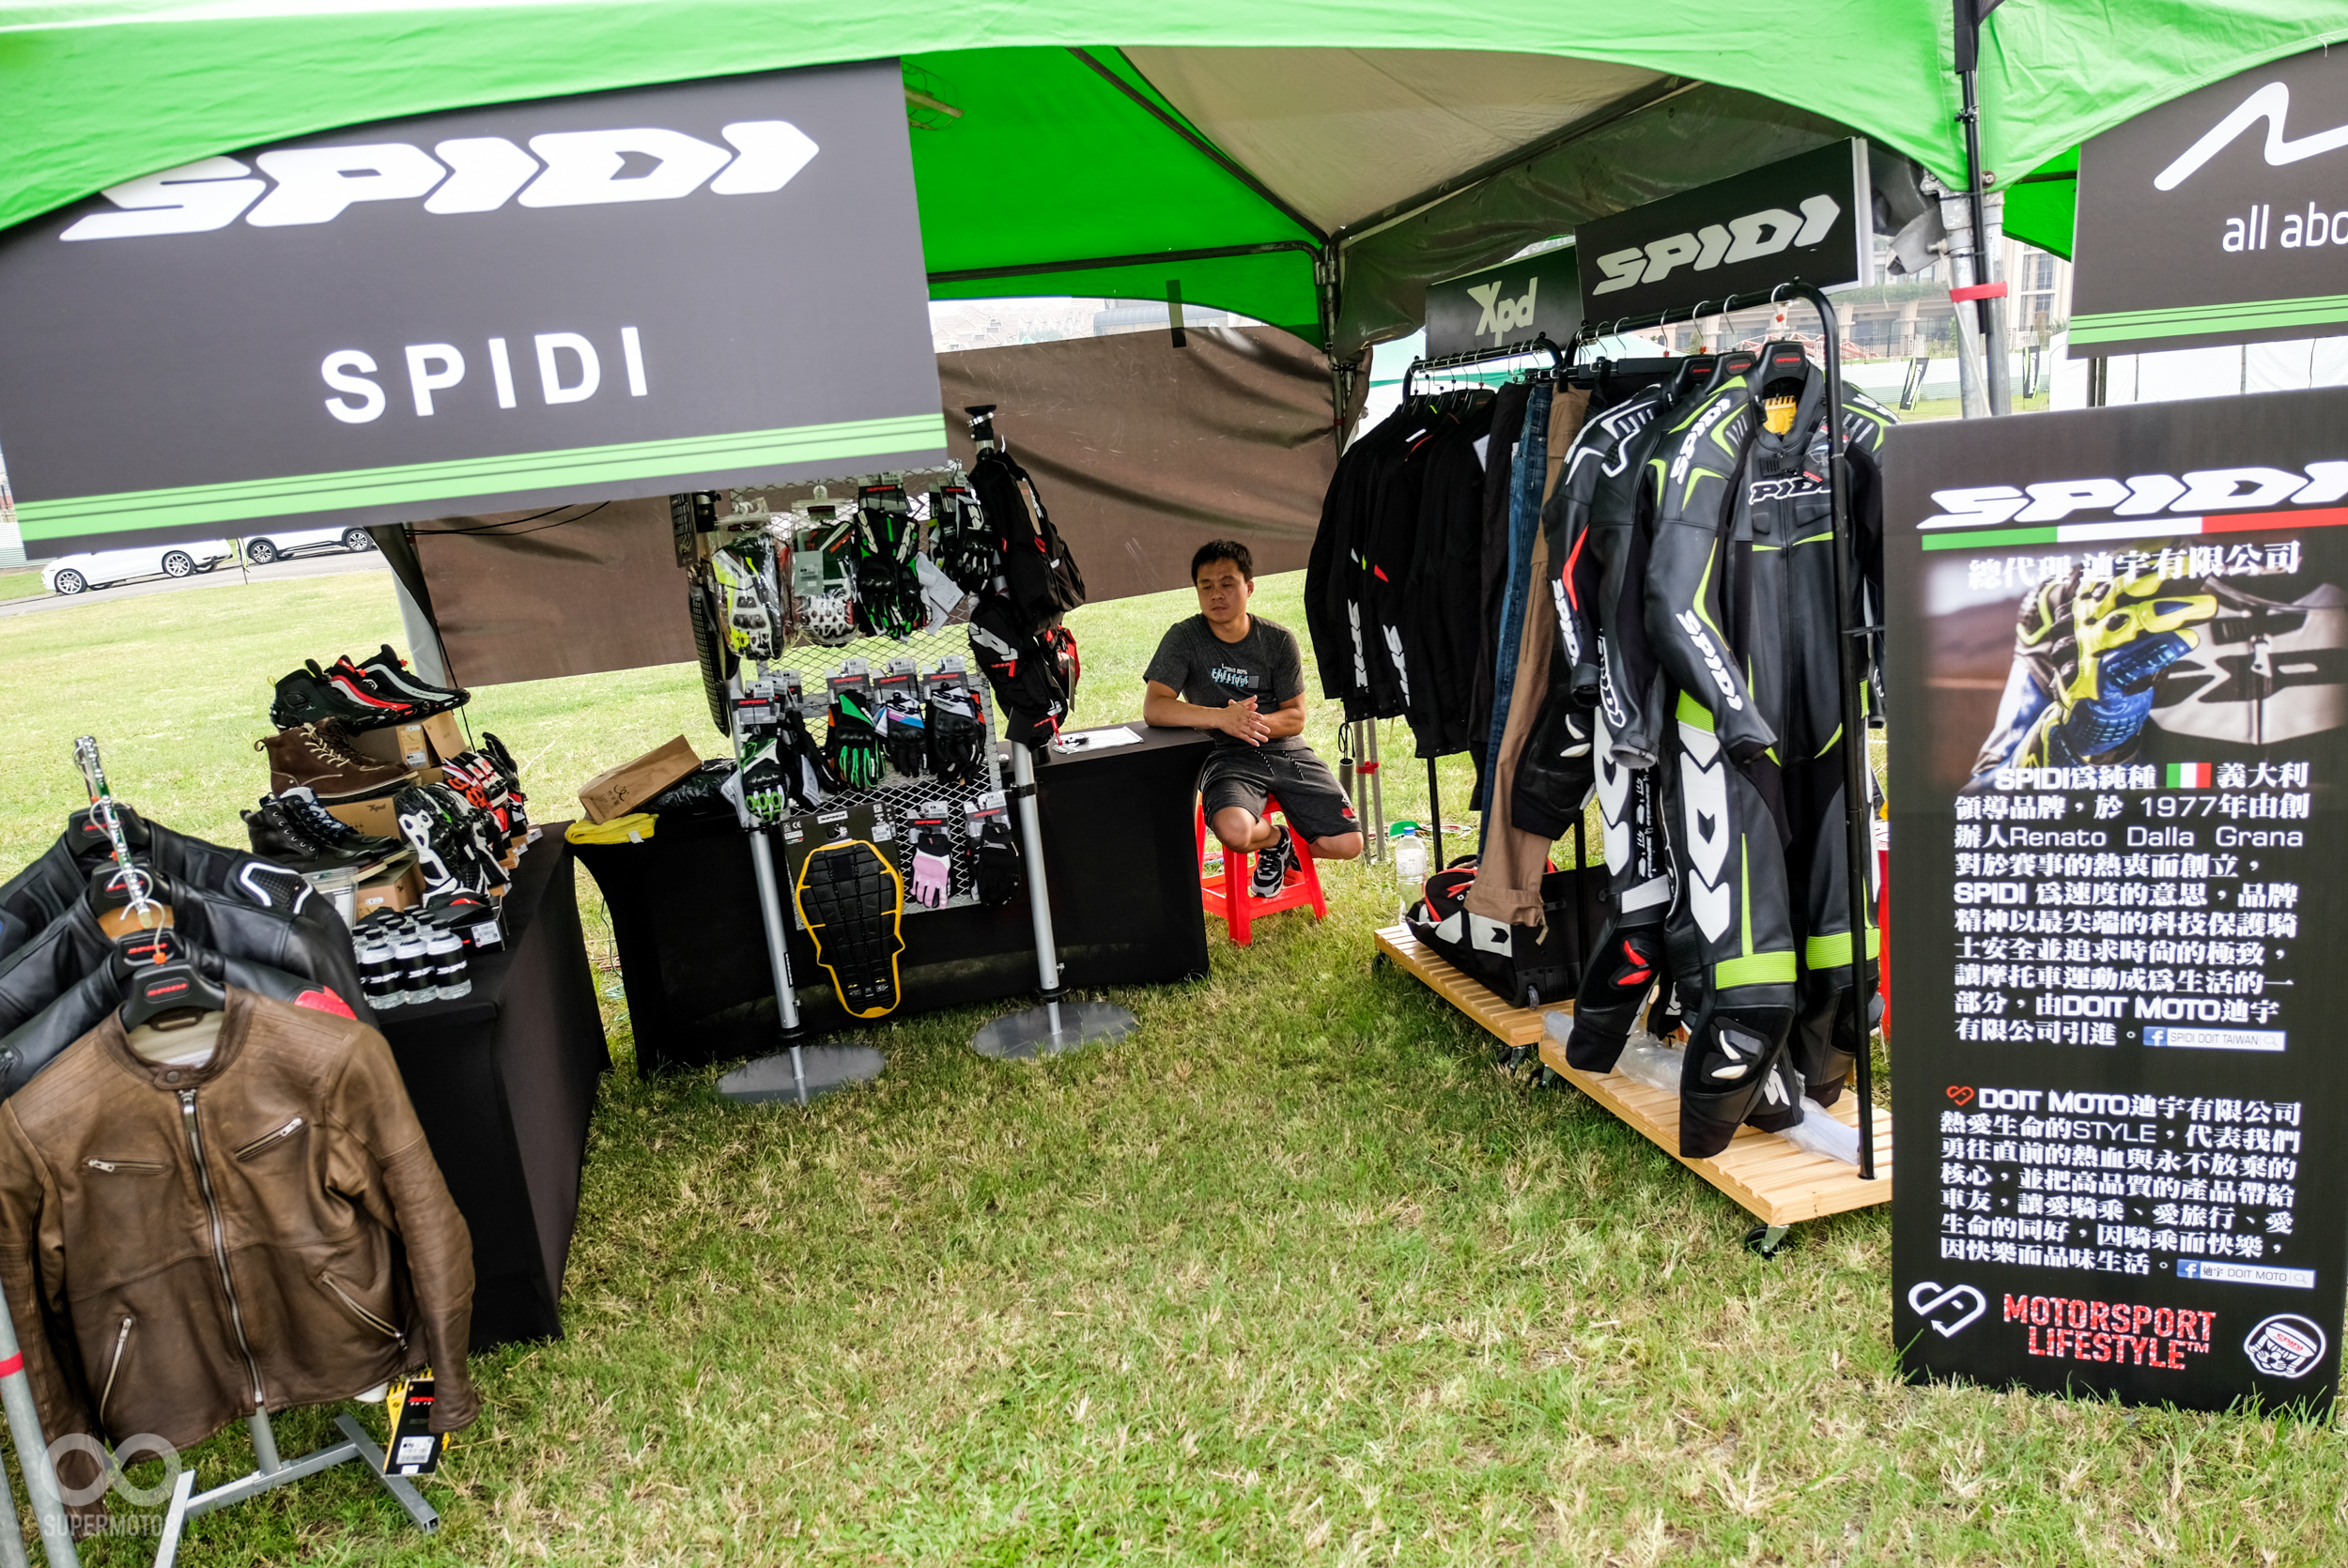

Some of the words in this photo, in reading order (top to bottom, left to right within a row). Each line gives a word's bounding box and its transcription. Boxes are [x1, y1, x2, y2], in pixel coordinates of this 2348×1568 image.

[60, 119, 820, 241] SPIDI
[1592, 193, 1842, 296] SPIDI
[2222, 204, 2269, 253] all
[1466, 276, 1537, 347] Xpd
[320, 325, 649, 425] SPIDI
[1670, 398, 1731, 484] SPIDI
[1917, 461, 2348, 529] SPIDI
[1968, 555, 2072, 591] 總代理
[1676, 609, 1743, 711] SPIDI
[2217, 761, 2309, 789] 義大利
[2140, 792, 2310, 820] 1977年由創
[1954, 823, 2107, 848] 辦人Renato
[2127, 825, 2195, 847] Dalla
[2216, 826, 2304, 847] Grana
[1954, 882, 2027, 904] SPIDI
[147, 983, 188, 996] SPIDI
[2170, 1032, 2196, 1043] SPIDI
[2199, 1034, 2220, 1044] DOIT
[2223, 1034, 2259, 1045] TAIWAN
[1979, 1088, 2043, 1111] DOIT
[2228, 1268, 2252, 1278] DOIT
[2255, 1270, 2287, 1282] MOTO
[2003, 1293, 2217, 1342] MOTORSPORT
[2273, 1332, 2304, 1352] SPIDI
